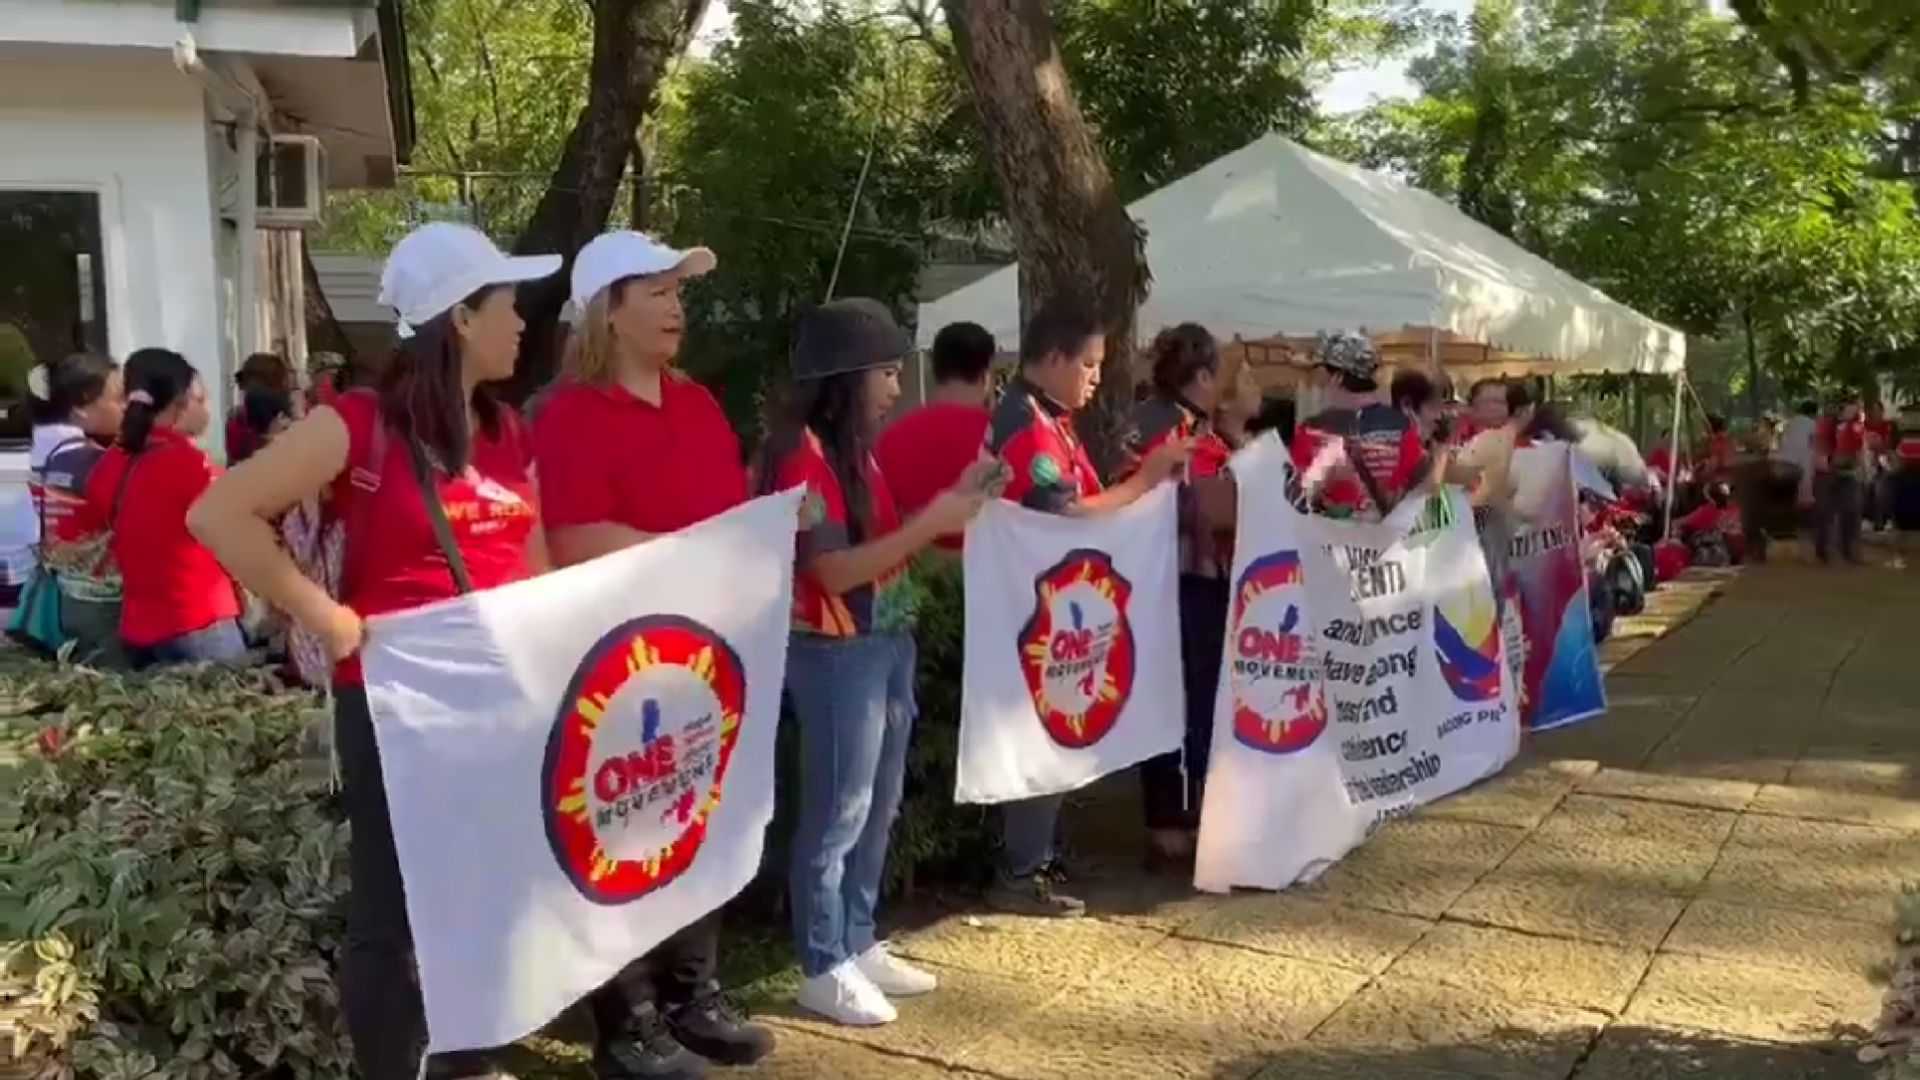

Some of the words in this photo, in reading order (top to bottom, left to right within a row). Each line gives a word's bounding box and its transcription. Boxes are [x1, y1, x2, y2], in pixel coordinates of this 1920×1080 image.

[1051, 628, 1095, 662] ONE
[1238, 627, 1302, 663] ONE
[594, 735, 676, 802] ONE
